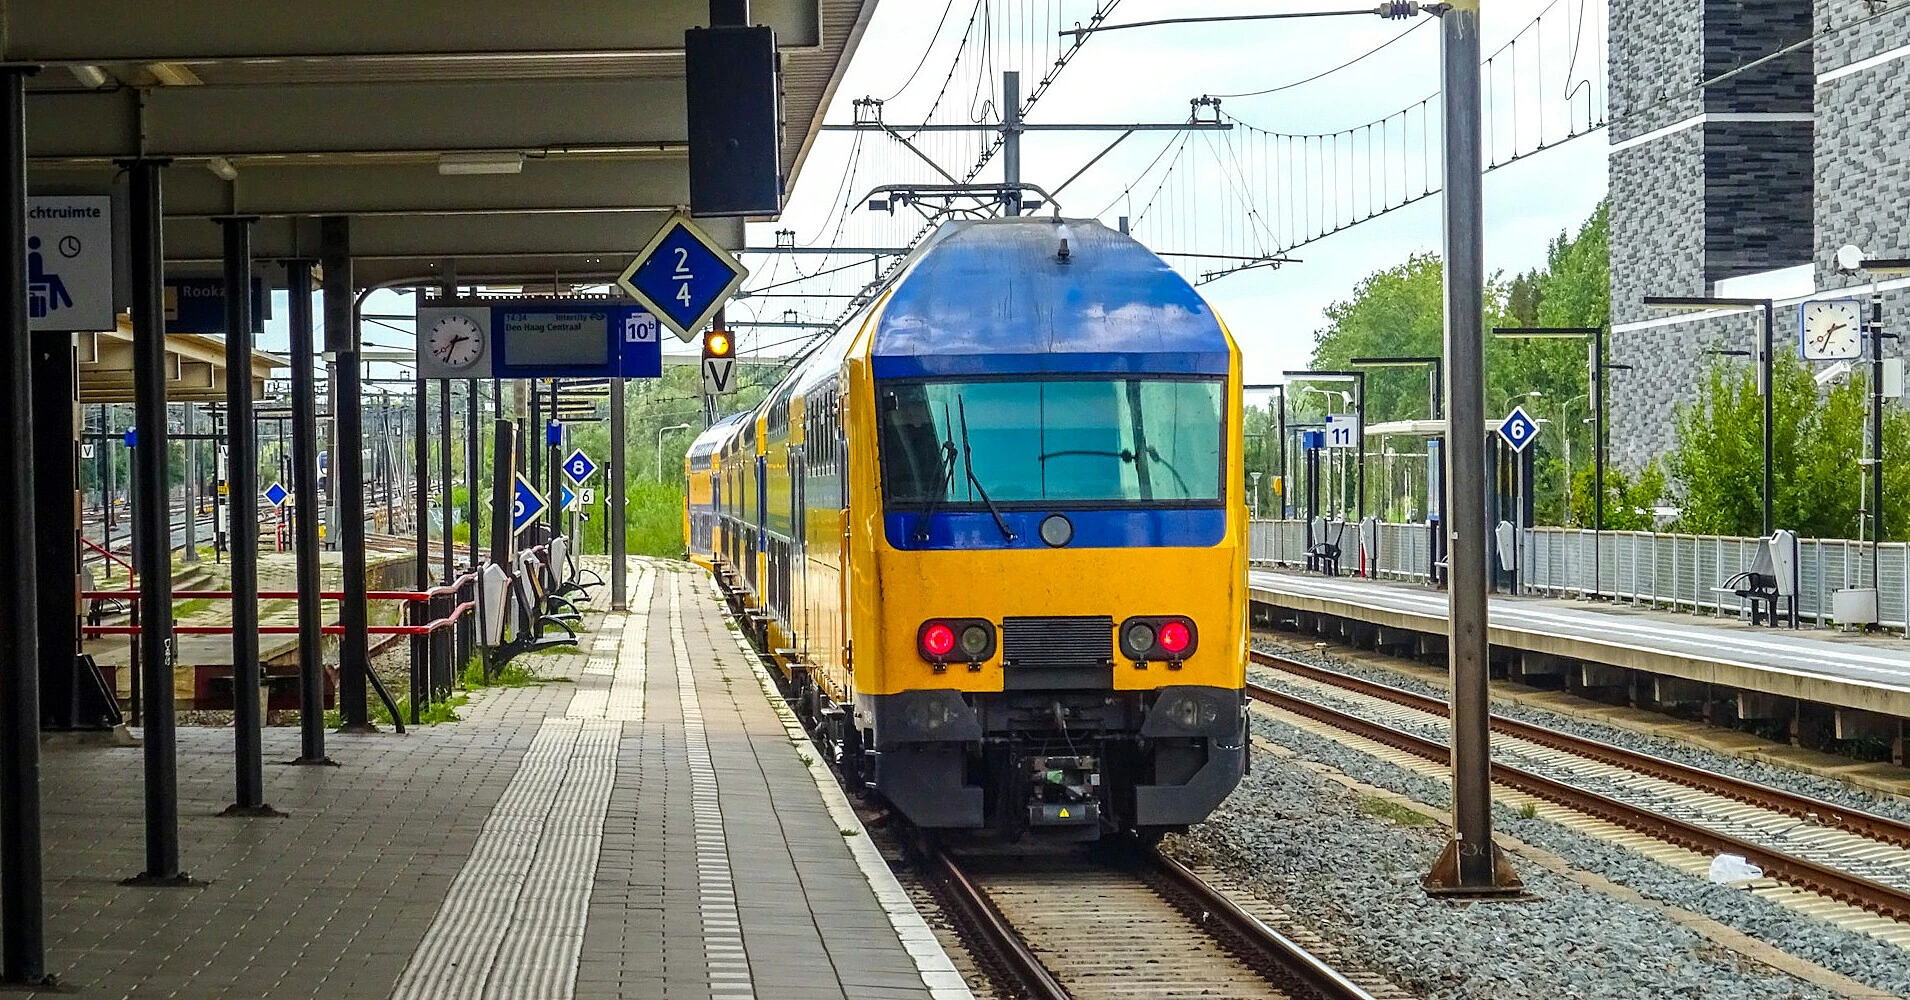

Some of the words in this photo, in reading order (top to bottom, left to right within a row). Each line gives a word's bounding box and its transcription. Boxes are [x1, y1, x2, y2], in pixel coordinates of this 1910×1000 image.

[30, 206, 101, 219] chtruimte
[674, 247, 690, 273] 2
[676, 282, 691, 308] 4
[507, 323, 522, 331] Den
[524, 323, 545, 333] Haag
[547, 323, 581, 331] Centraal
[708, 361, 733, 392] V
[1332, 428, 1350, 445] 11
[1511, 419, 1525, 440] 6
[83, 446, 92, 456] V
[572, 460, 585, 475] 8
[582, 490, 590, 503] 6
